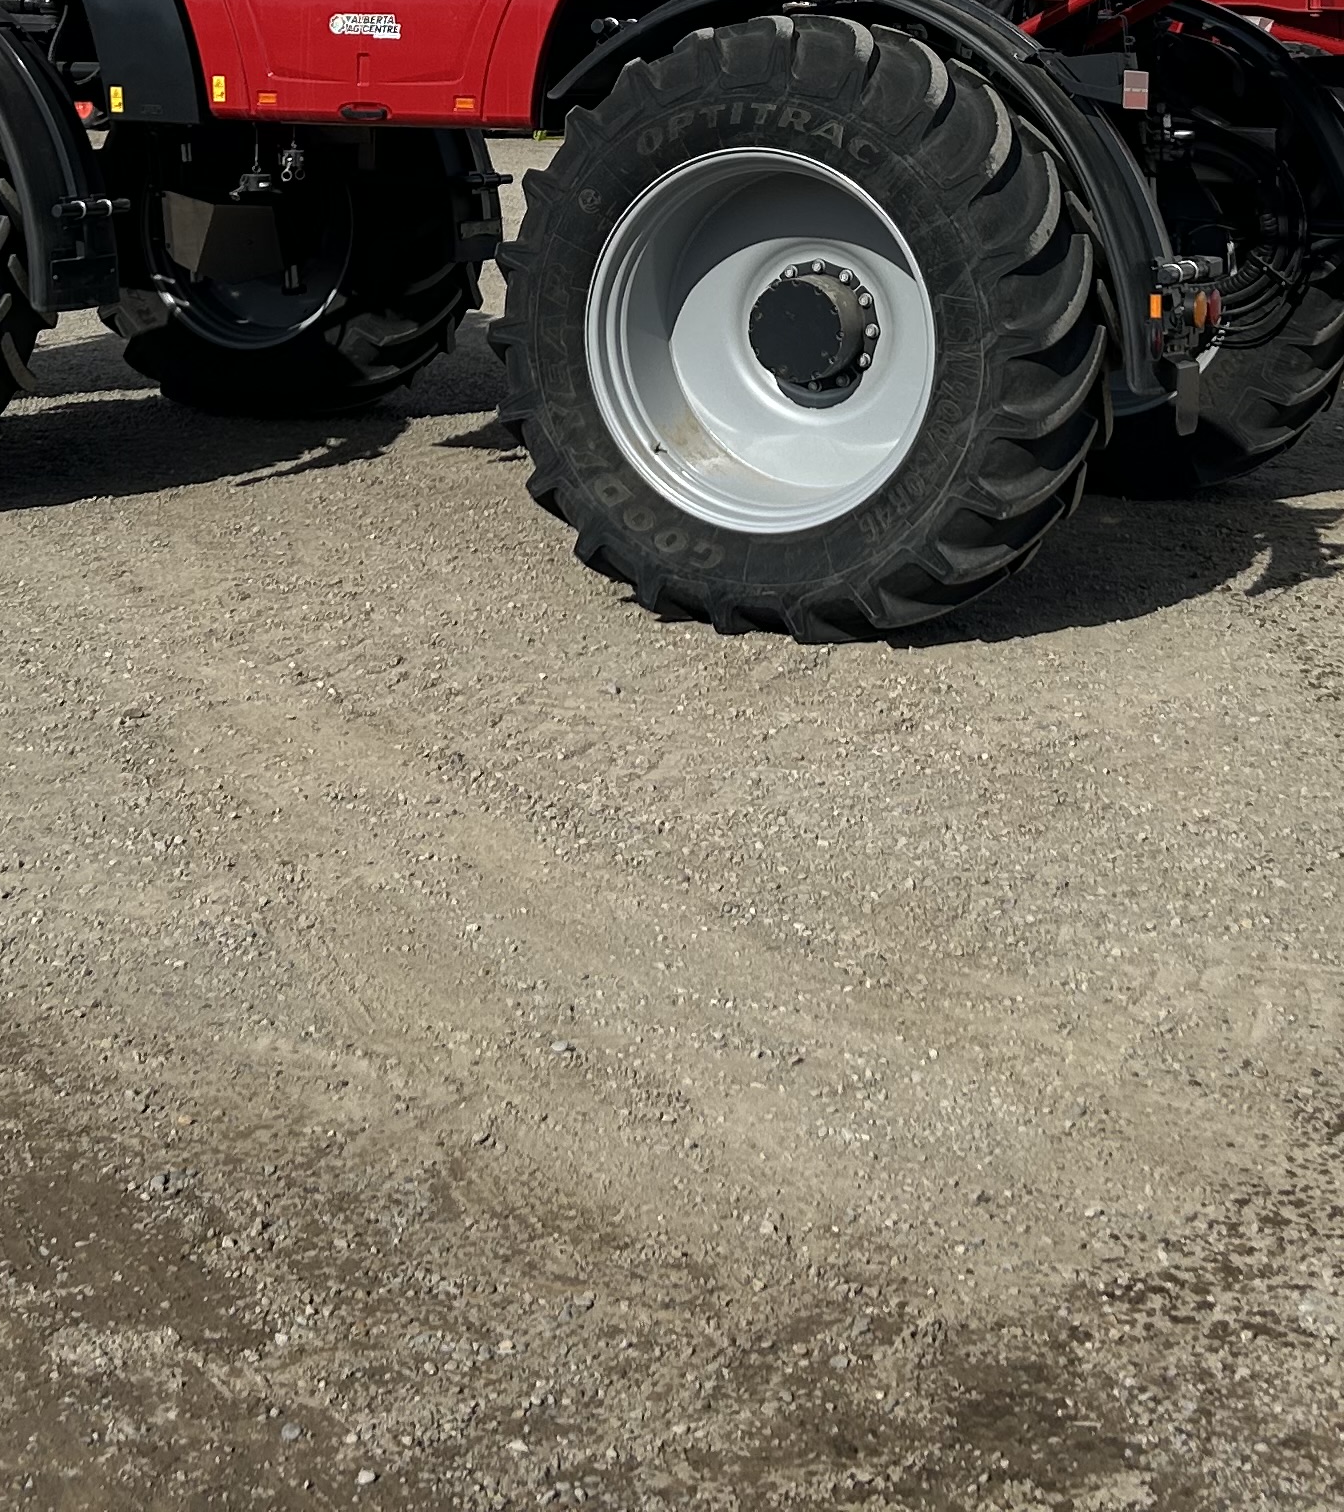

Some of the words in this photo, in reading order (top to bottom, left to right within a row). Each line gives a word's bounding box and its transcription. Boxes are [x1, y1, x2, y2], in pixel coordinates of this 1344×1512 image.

[351, 15, 394, 24] ALBERTA
[362, 24, 399, 34] CENTRE
[637, 101, 880, 165] OPTITRAC
